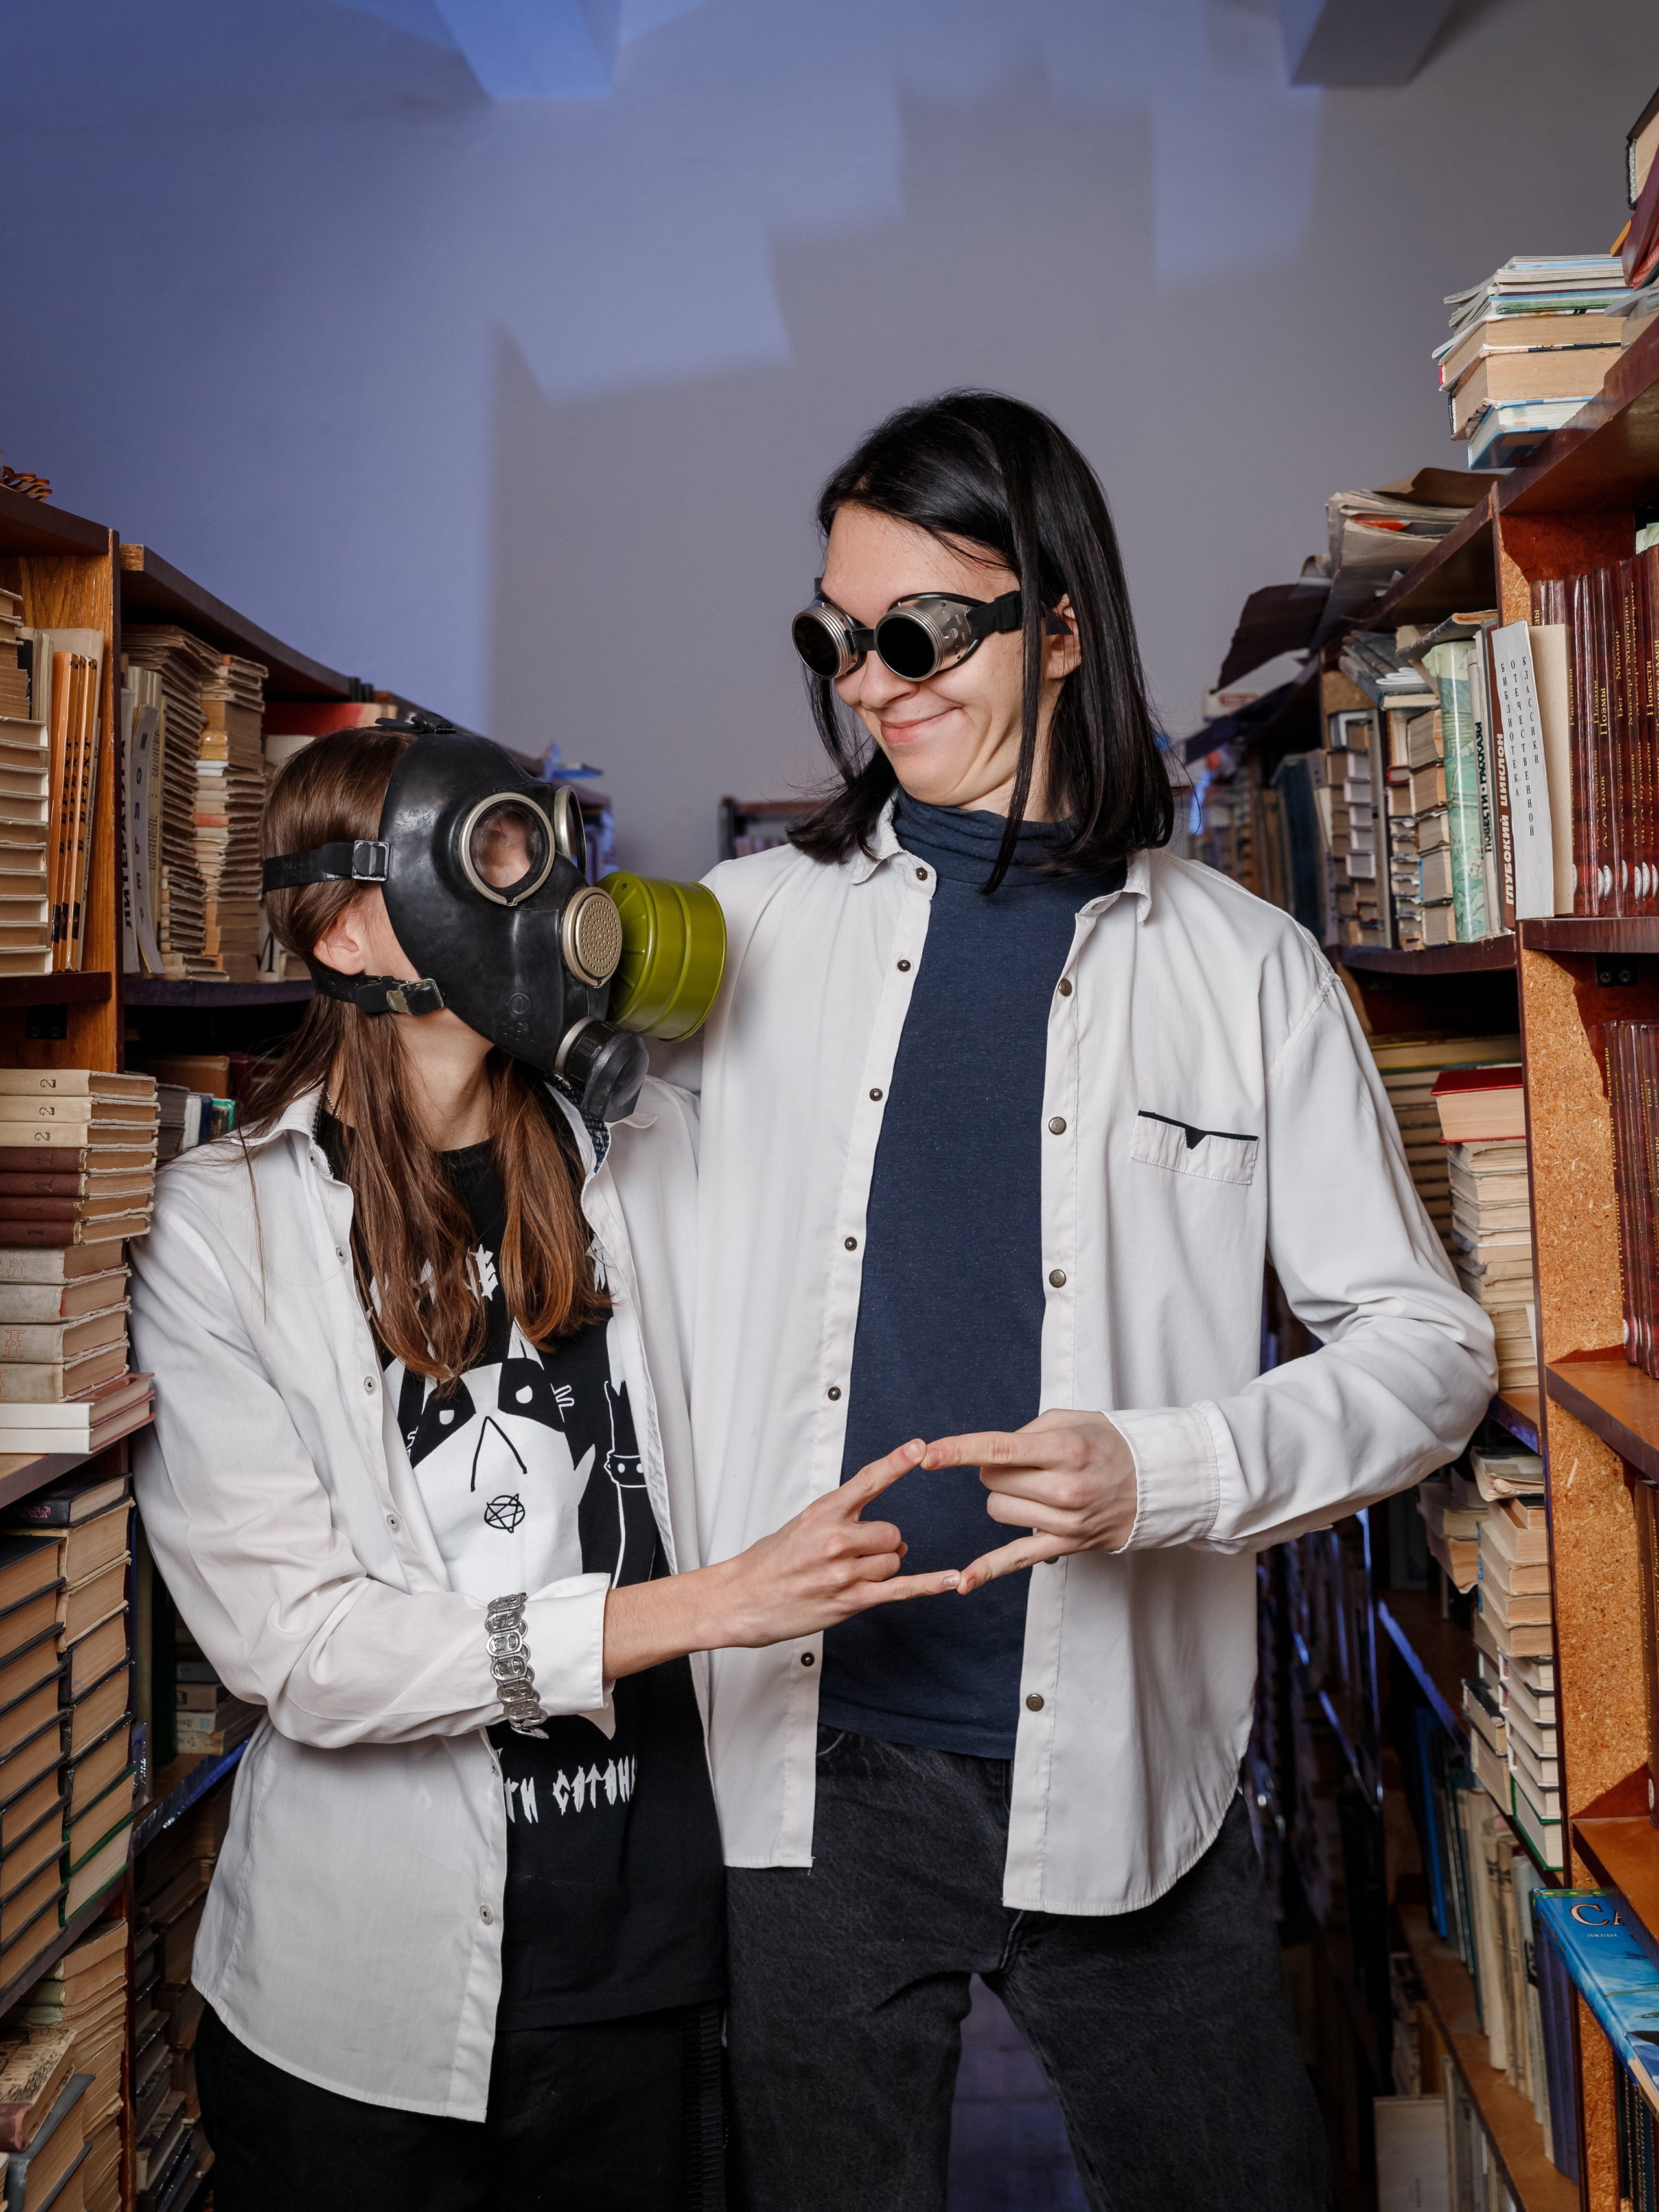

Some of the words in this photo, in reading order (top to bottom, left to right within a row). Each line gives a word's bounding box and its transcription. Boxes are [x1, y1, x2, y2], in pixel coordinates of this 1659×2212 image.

[1500, 663, 1520, 797] БИБЛИОТЕКА
[1511, 659, 1535, 836] ОТЕЧЕСТВЕННОЙ
[1522, 656, 1539, 765] КЛАССИКИ
[1496, 733, 1509, 807] ЦИКЛОН
[1500, 814, 1515, 905] ГЛУБОКИЙ
[39, 1106, 55, 1116] 2
[40, 1078, 56, 1089] 2
[34, 1131, 51, 1142] 2
